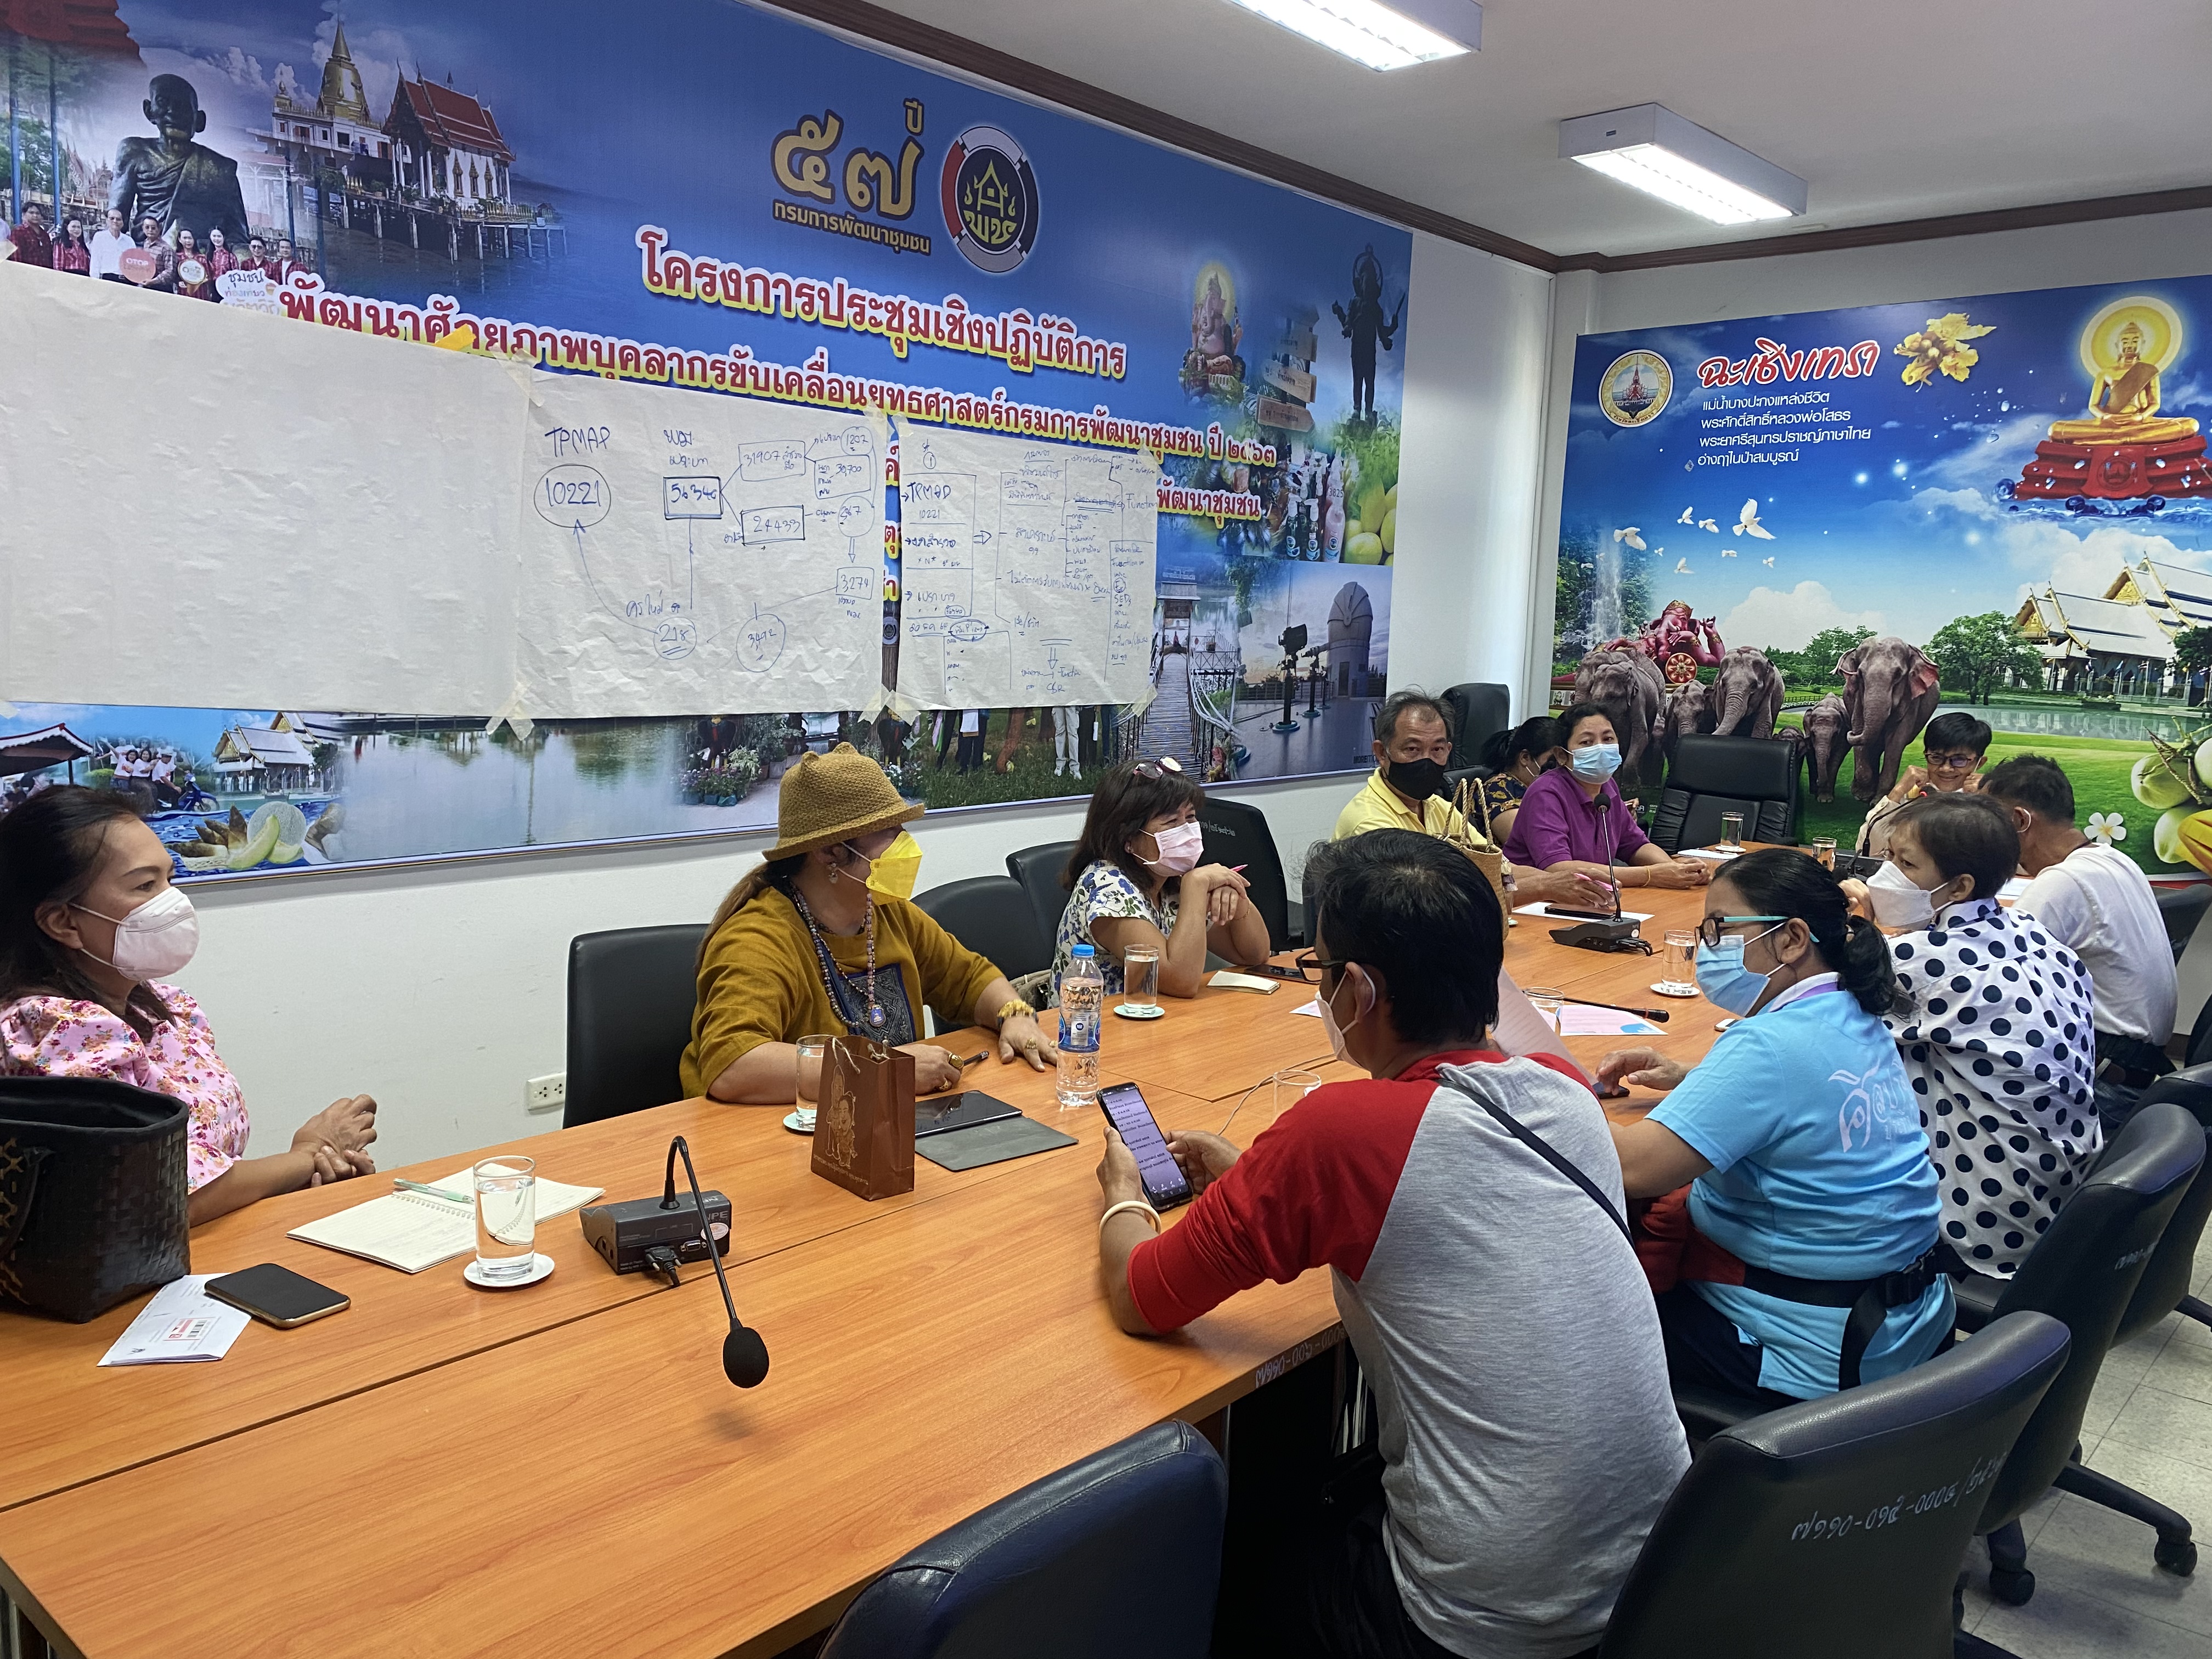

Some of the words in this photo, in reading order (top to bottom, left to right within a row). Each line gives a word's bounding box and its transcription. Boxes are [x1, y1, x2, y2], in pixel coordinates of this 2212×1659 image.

[903, 98, 924, 134] ปี
[774, 198, 931, 255] กรมการพัฒนาชุมชน
[228, 271, 264, 287] ชุมชน
[640, 227, 1126, 377] โครงการประชุมเชิงปฏิบัติการ
[280, 277, 1203, 460] พัฒนาศักยภาพบุคลากรขับเคลื่อนยทธศาสตร์กรมการพัฒนาชุมชน
[1209, 425, 1222, 456] ปี
[1697, 337, 1880, 388] ฉะเชิงเทรา
[1702, 391, 1830, 411] แม่น้ำบางปะกงแหล่งชีวิต
[1701, 408, 1851, 429] พระศักดิ์สิทธิ์หลวงพ่อโสธร
[545, 426, 611, 458] TPMAP
[1699, 426, 1871, 448] พระยาศรีสุนทรปราชญ์ภาษาไทย
[743, 450, 780, 467] 31907
[545, 478, 601, 507] 10221
[753, 516, 800, 533] 24433
[919, 509, 940, 520] 10221
[840, 574, 869, 592] 3,274
[658, 624, 689, 643] 218
